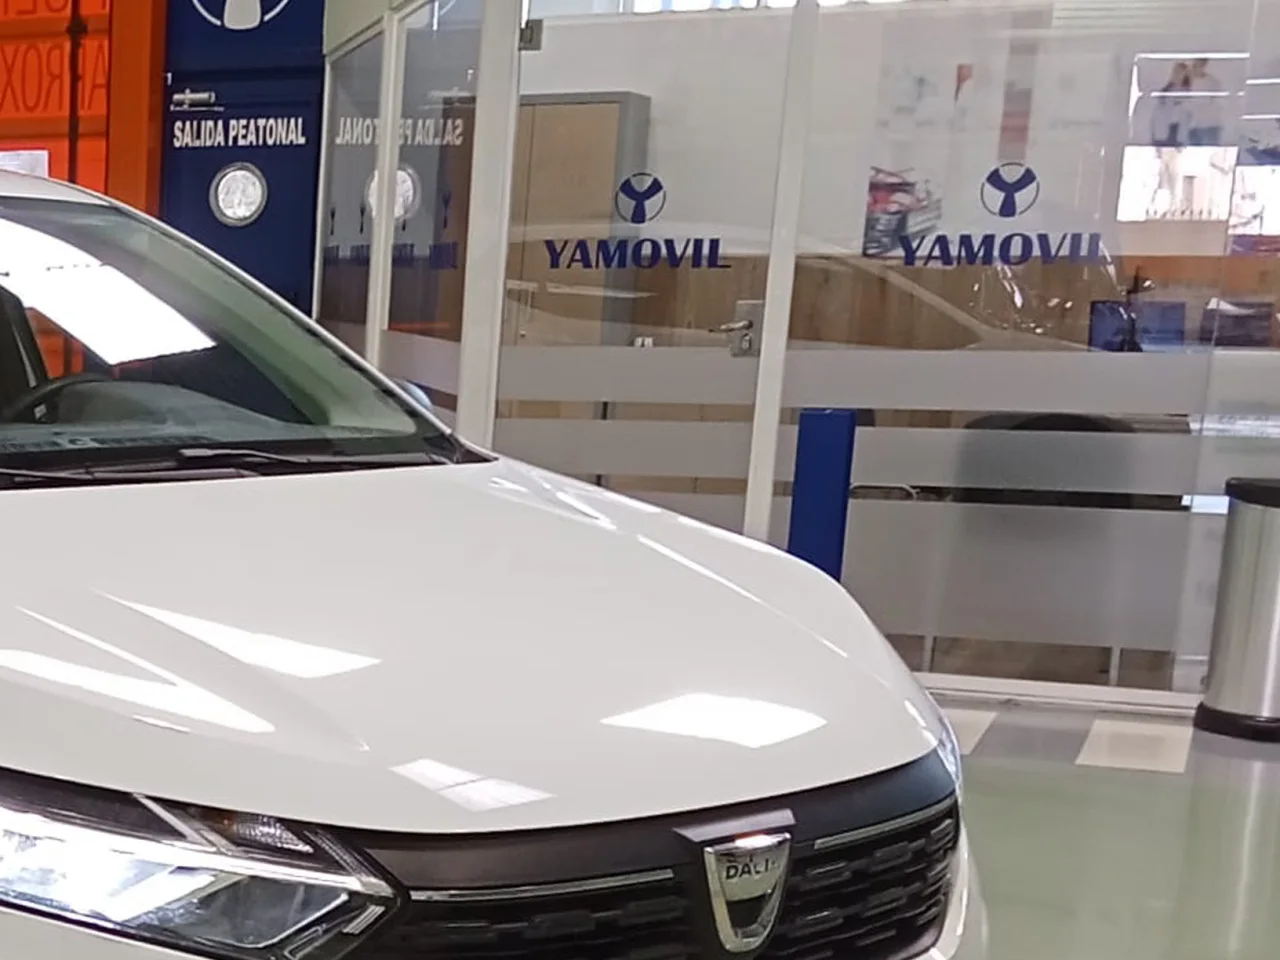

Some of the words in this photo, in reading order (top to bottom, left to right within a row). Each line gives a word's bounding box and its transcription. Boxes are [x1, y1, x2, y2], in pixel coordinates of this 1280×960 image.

[173, 119, 225, 148] SALIDA
[228, 117, 306, 147] PEATONAL
[544, 237, 732, 269] YAMOVIL
